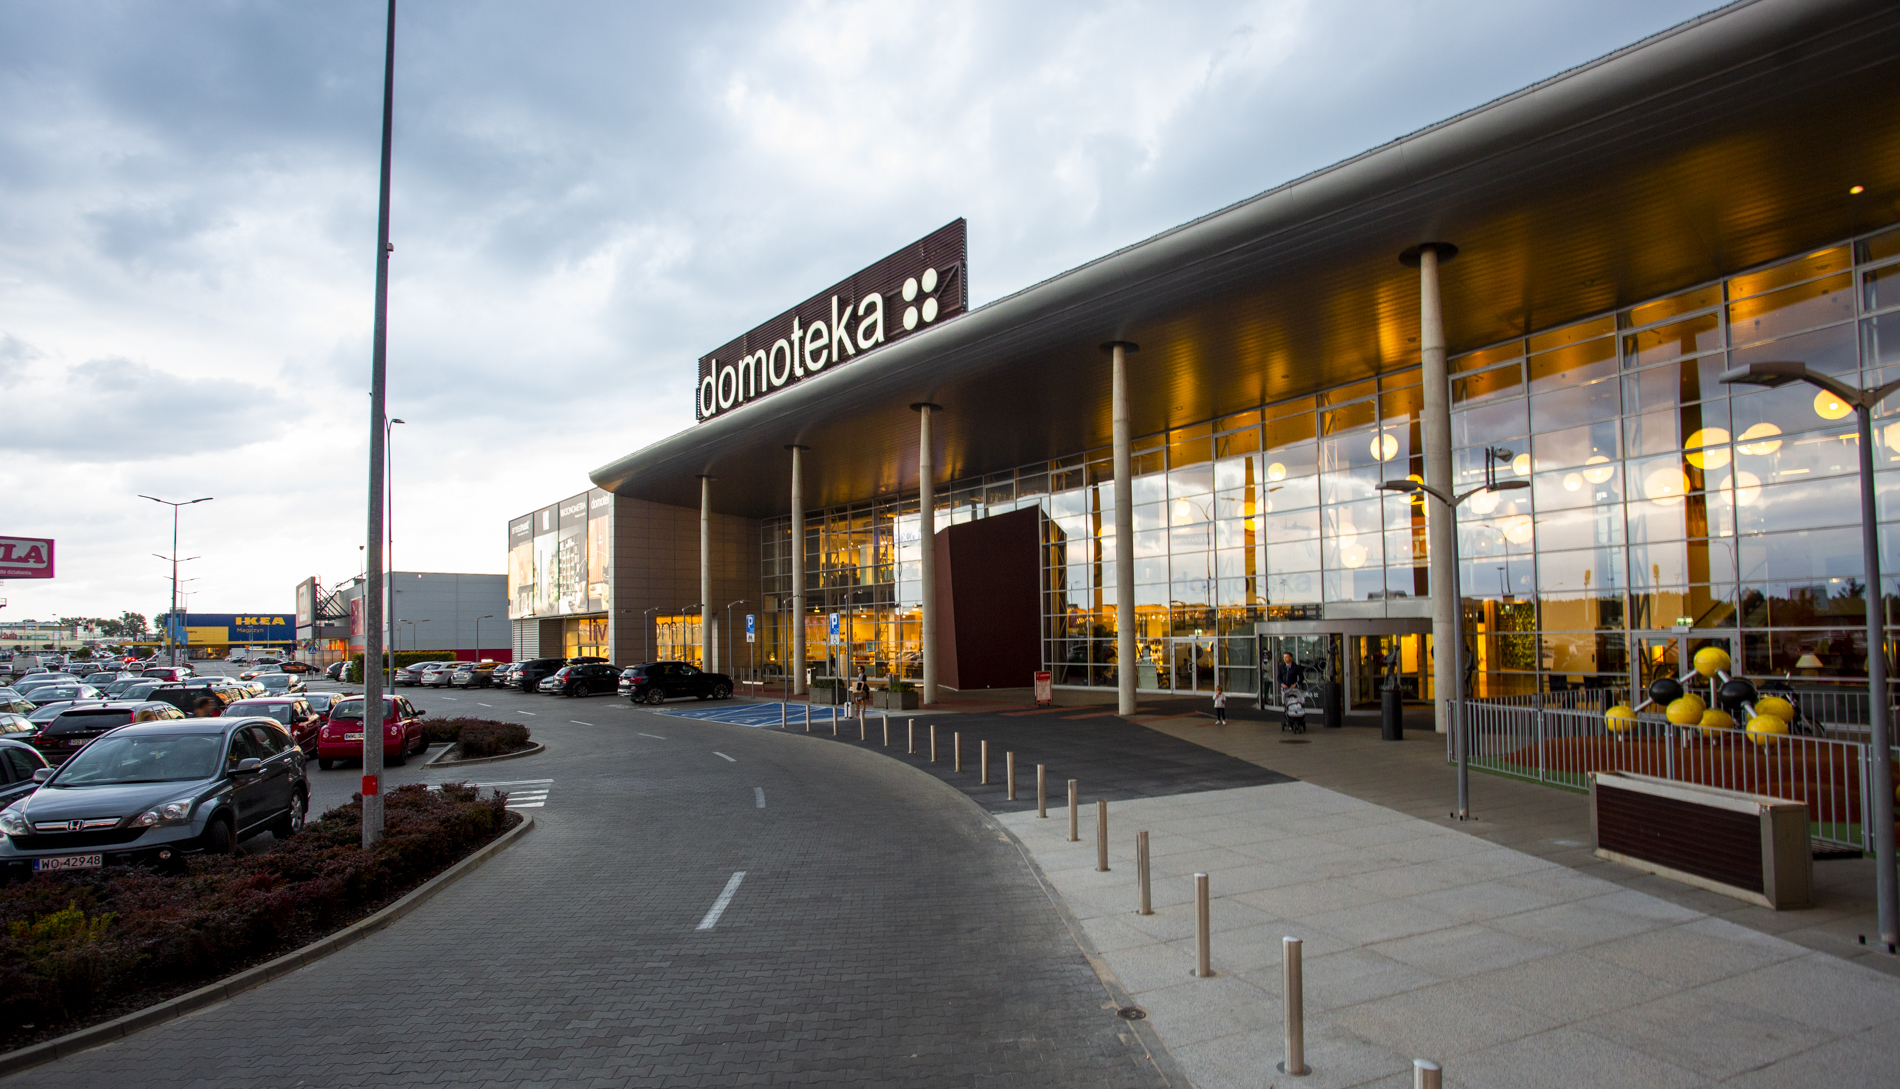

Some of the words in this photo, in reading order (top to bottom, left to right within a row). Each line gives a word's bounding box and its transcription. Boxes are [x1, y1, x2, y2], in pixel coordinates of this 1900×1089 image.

[700, 292, 885, 418] domoteka
[0, 543, 46, 565] LA
[235, 616, 286, 626] IKEA
[748, 616, 754, 629] P
[831, 615, 838, 628] P
[41, 858, 60, 870] WO
[63, 855, 101, 868] 42948
